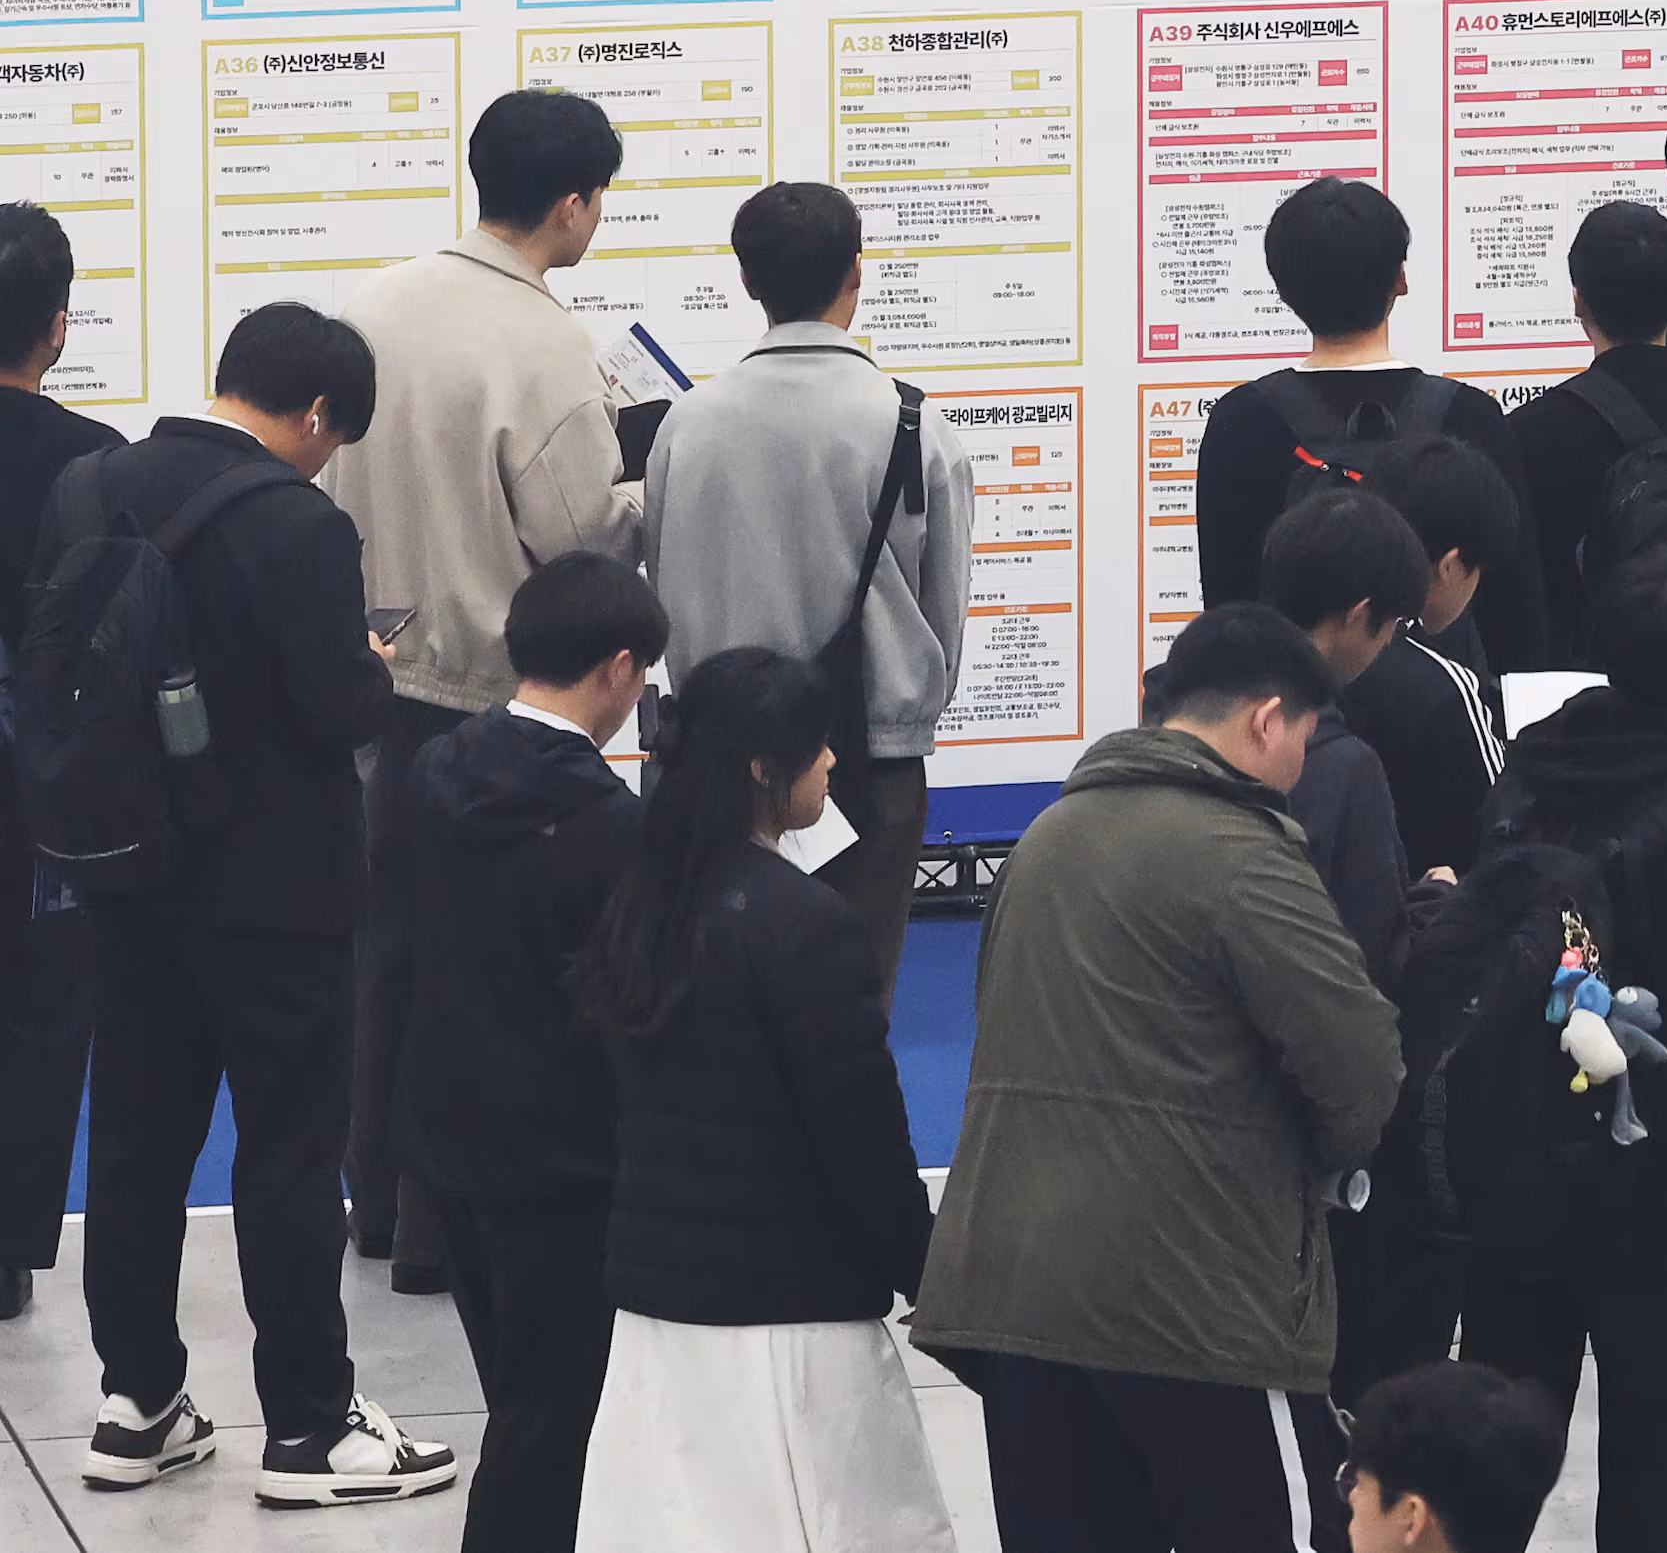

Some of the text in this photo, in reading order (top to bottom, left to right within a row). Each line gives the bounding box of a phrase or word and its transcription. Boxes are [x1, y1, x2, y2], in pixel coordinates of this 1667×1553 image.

[1149, 19, 1360, 42] A39 주식회사 신우에프에스
[1455, 9, 1667, 32] A40 휴먼스토리에프에스(주)
[529, 40, 683, 64] A37 (주)명진로직스
[841, 29, 1008, 53] A38 천하종합관리(주)
[214, 51, 386, 74] A36 (주)신안정보통신
[1012, 404, 1072, 424] 광교빌리지
[1150, 401, 1192, 418] A47
